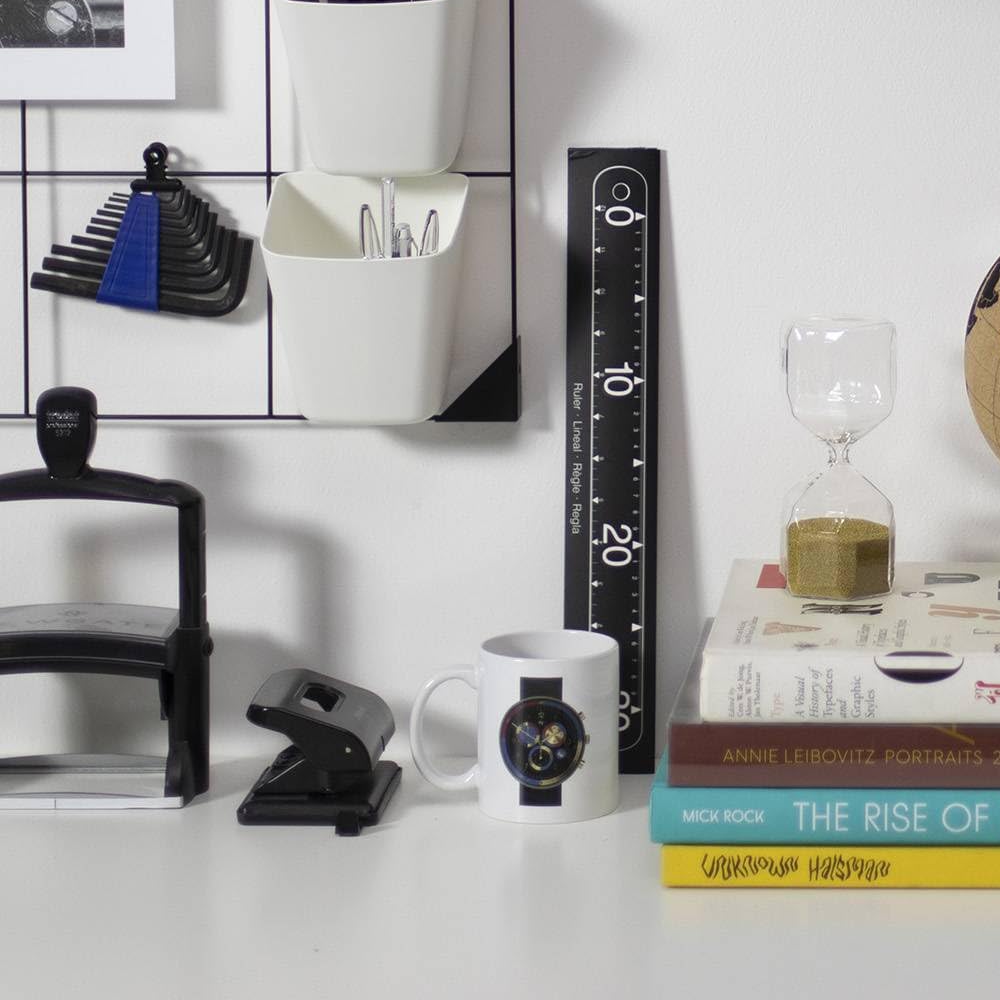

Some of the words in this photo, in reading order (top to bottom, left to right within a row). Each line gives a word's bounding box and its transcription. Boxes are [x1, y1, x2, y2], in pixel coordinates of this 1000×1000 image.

[604, 205, 635, 227] 0
[603, 361, 635, 397] 10
[572, 382, 584, 411] Ruler
[572, 420, 583, 453] Lineal
[570, 462, 583, 494] Règle
[570, 503, 583, 535] Regla
[602, 523, 634, 567] 20
[808, 667, 822, 681] of
[771, 692, 784, 719] Type
[794, 677, 804, 705] Visual
[808, 682, 821, 718] History
[822, 668, 837, 717] Typefaces
[851, 676, 863, 717] Graphic
[865, 689, 878, 718] Styles
[794, 707, 804, 717] A
[838, 699, 849, 718] and
[722, 748, 779, 766] ANNIE
[783, 748, 876, 766] LEIBOVITZ
[884, 750, 983, 766] PORTRAITS
[682, 808, 720, 823] MICK
[723, 808, 765, 824] ROCK
[792, 800, 849, 832] THE
[864, 801, 928, 833] RISE
[941, 801, 990, 833] OF
